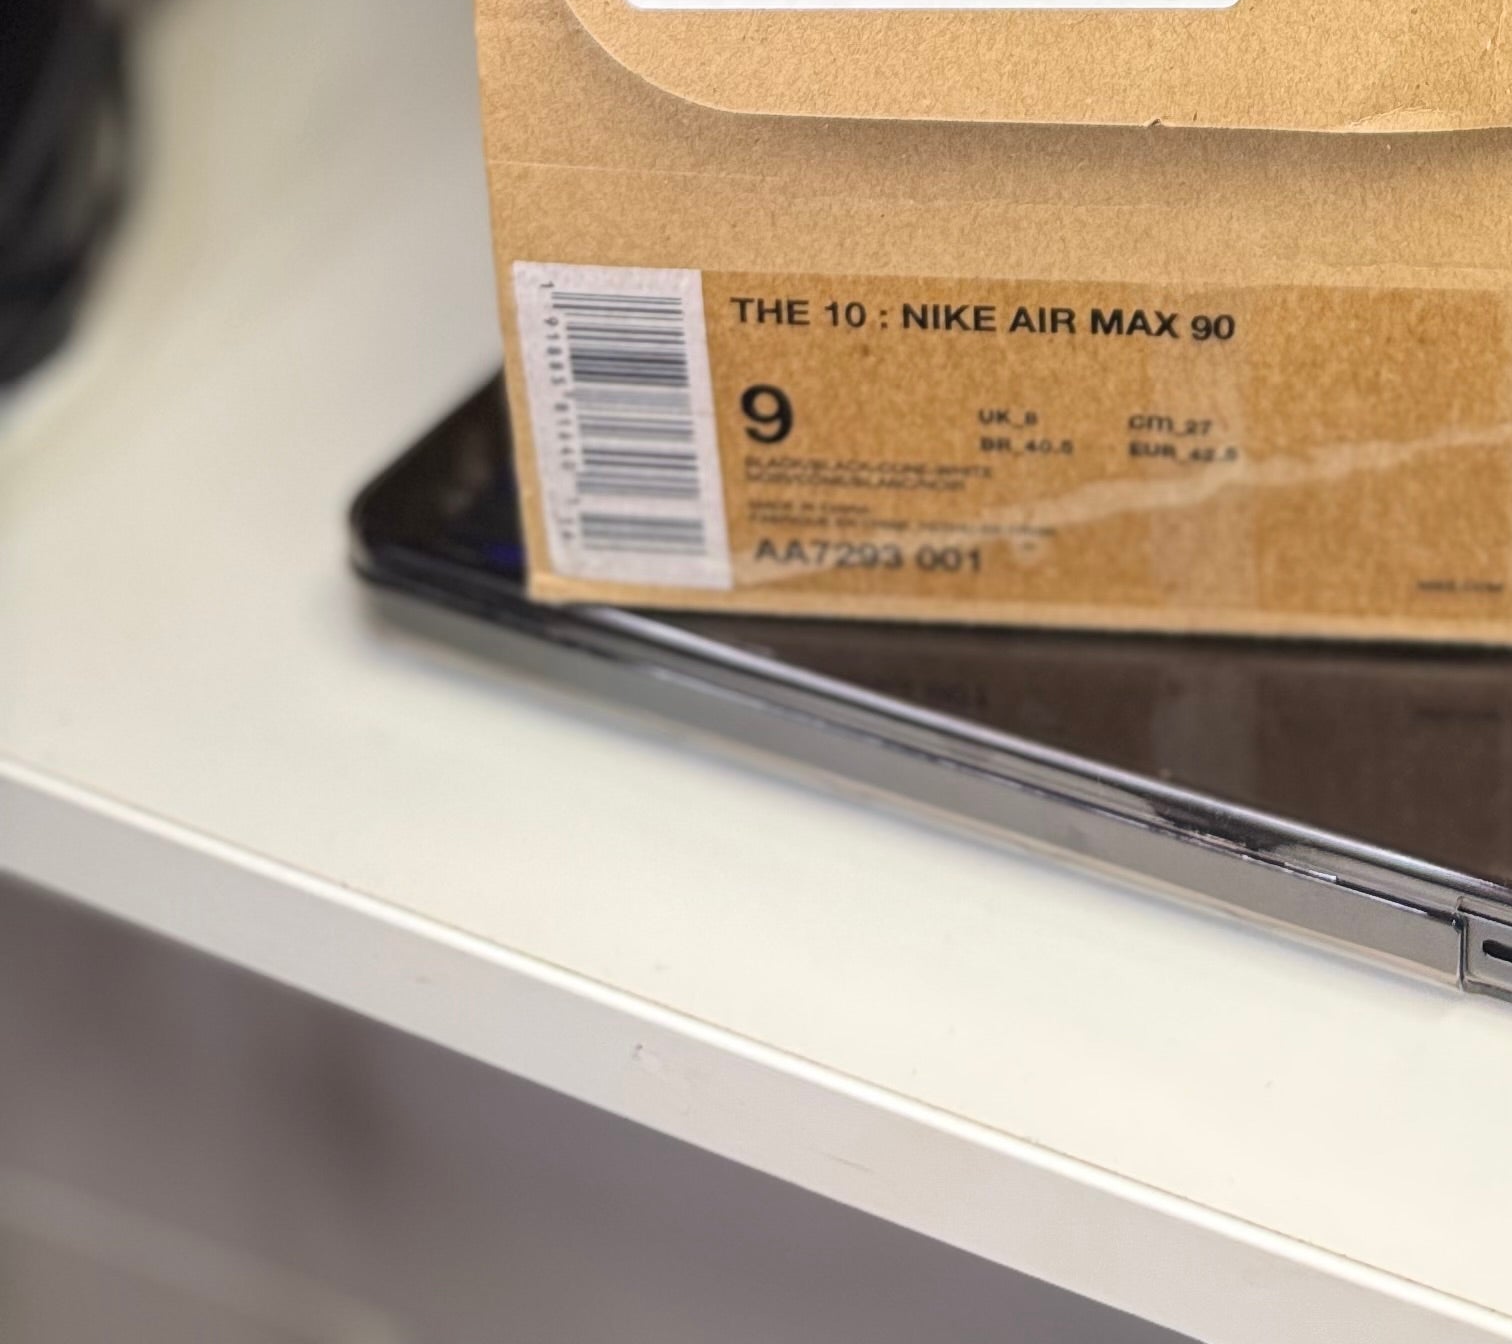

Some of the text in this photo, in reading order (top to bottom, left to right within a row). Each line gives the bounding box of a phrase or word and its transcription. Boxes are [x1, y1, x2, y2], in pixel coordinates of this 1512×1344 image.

[730, 296, 811, 327] THE
[825, 301, 867, 329] 10
[903, 303, 997, 333] NIKE
[1009, 306, 1077, 335] AIR
[1090, 309, 1181, 340] MAX
[1191, 314, 1236, 342] 90
[740, 383, 794, 445] 9
[754, 537, 982, 574] AA7293 001
